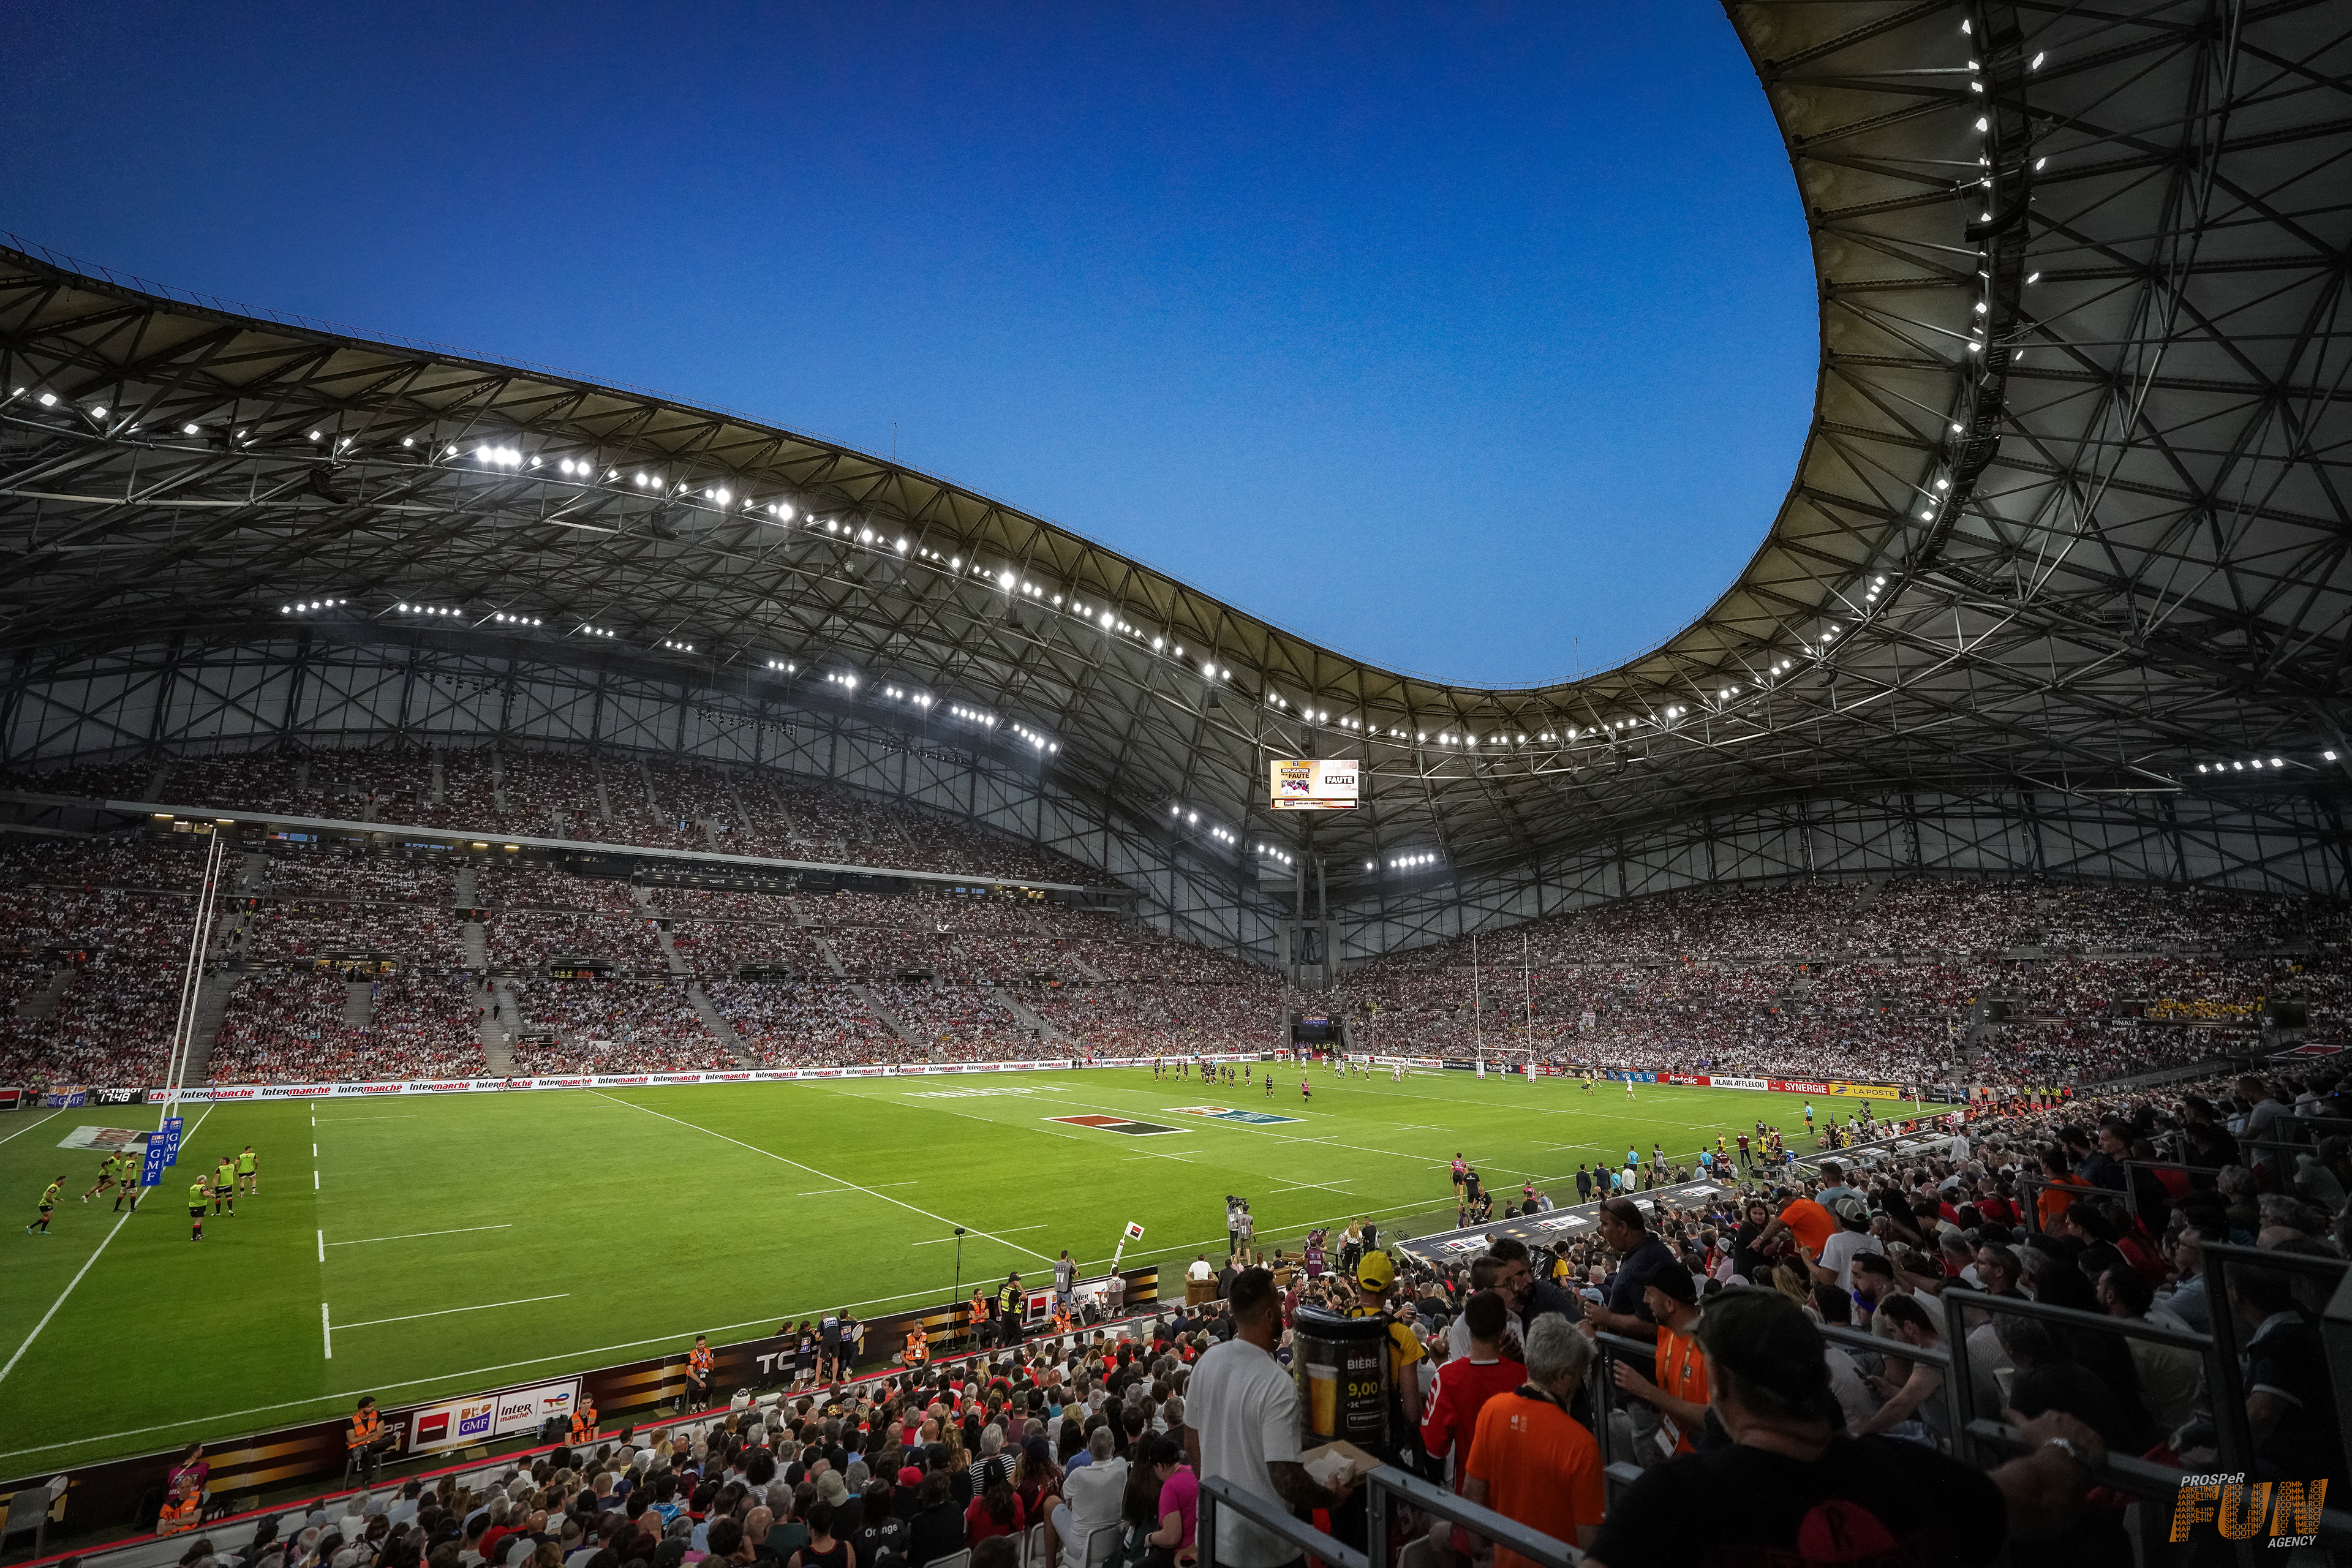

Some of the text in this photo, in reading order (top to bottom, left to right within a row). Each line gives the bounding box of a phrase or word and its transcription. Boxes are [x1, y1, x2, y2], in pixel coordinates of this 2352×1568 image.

[653, 1074, 701, 1083] Intermarché
[802, 1069, 842, 1078] Intermarché
[598, 1076, 648, 1085] Intermarché
[1669, 1075, 1698, 1084] Betclic
[338, 1084, 402, 1094] Intermarché
[410, 1082, 470, 1091] Intermarché
[476, 1080, 533, 1091] Intermrché
[1785, 1082, 1828, 1093] SYNERGIE
[180, 1089, 254, 1100] Intermarché
[262, 1086, 331, 1097] Intermarché
[58, 1096, 84, 1105] GMF
[100, 1093, 130, 1102] 17:48
[165, 1133, 178, 1163] GMF
[146, 1149, 161, 1182] GMF
[1055, 1272, 1065, 1283] TV
[1348, 1356, 1378, 1370] BIÈRE
[1348, 1381, 1378, 1398] 9,00
[500, 1404, 533, 1416] Inter
[541, 1406, 568, 1415] TotalEnergies
[499, 1411, 529, 1423] marché
[461, 1418, 489, 1432] GMF
[865, 1523, 898, 1538] Ornge
